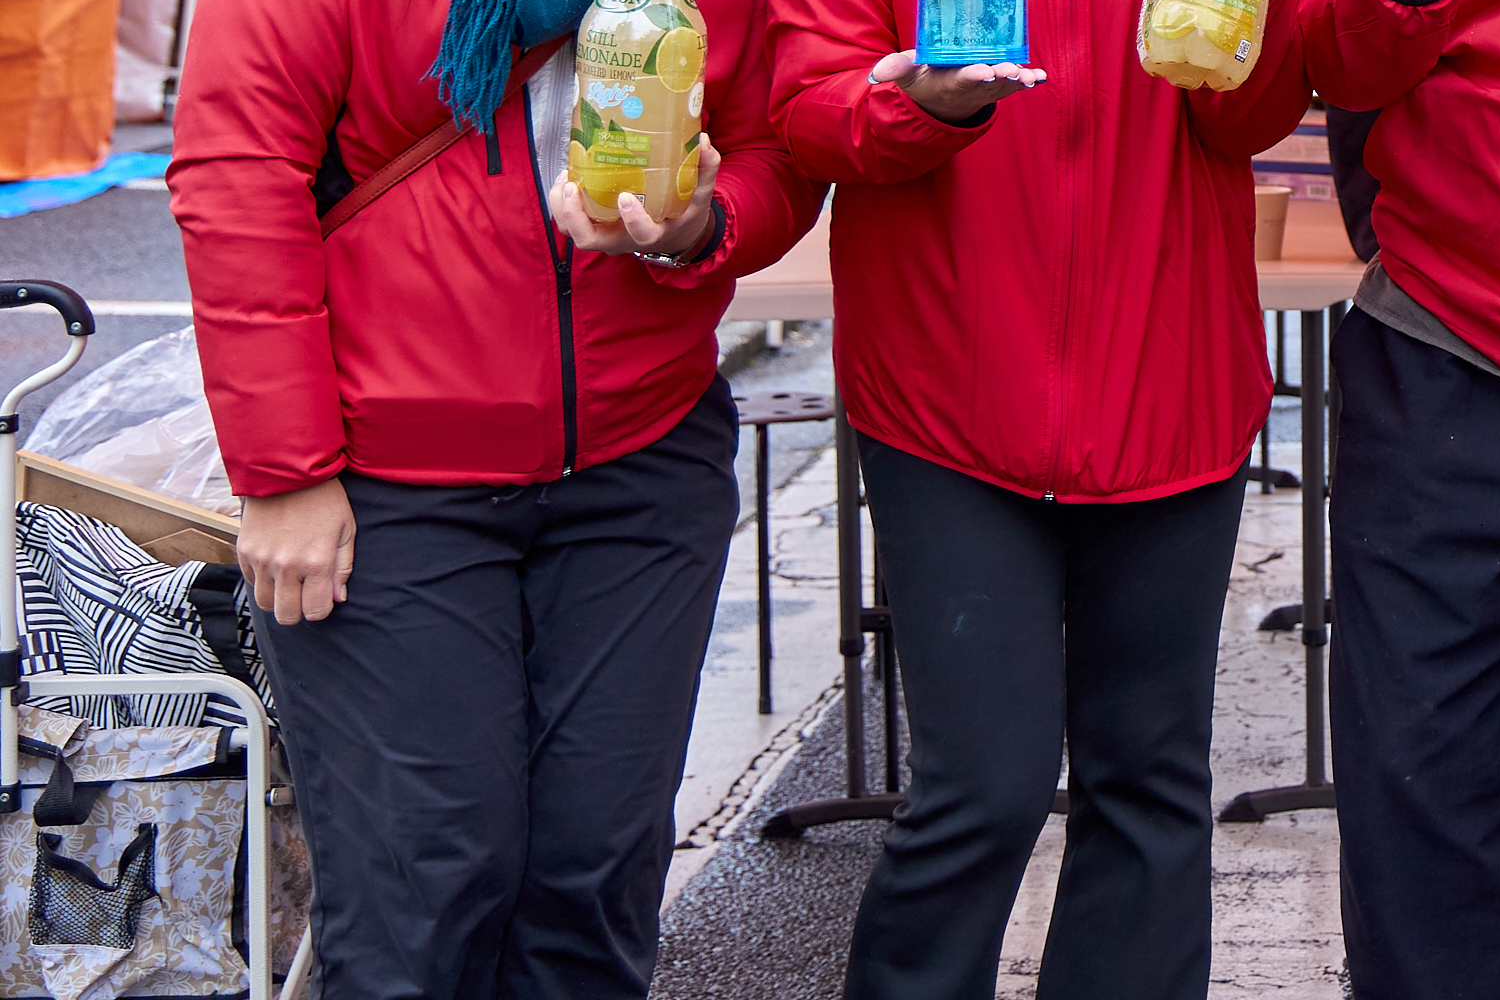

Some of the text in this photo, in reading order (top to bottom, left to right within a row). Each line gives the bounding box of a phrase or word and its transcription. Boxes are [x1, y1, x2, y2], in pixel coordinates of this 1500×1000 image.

[586, 30, 618, 48] STILL
[576, 42, 642, 69] EMONADE
[610, 68, 636, 81] LEMONS
[587, 81, 629, 109] Light
